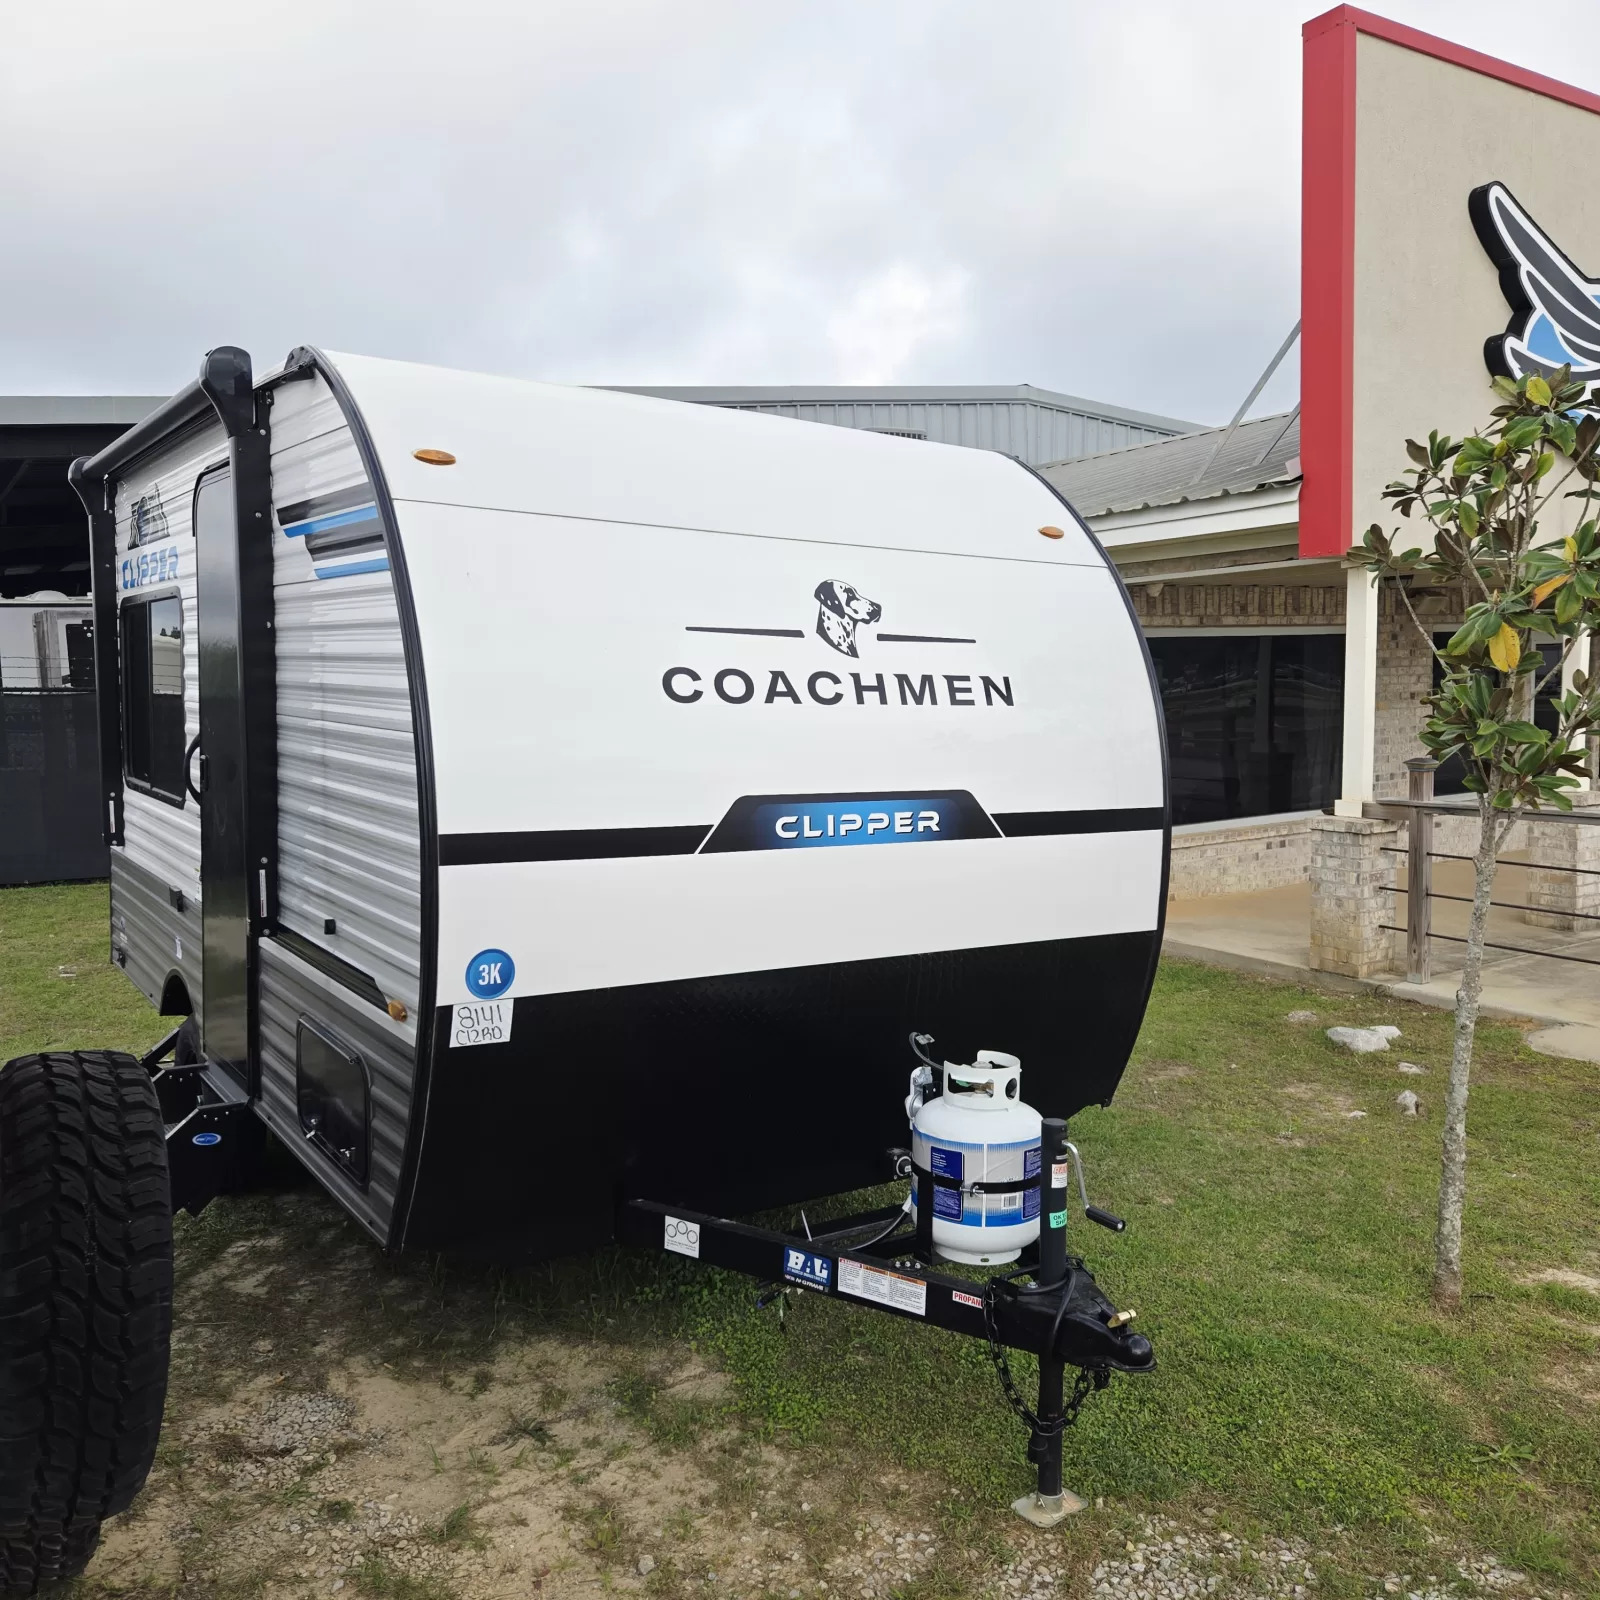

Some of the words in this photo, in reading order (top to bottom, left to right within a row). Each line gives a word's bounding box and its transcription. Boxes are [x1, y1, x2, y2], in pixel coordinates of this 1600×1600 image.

[122, 546, 179, 590] CLIPPER
[662, 667, 1015, 707] COACHMEN
[775, 810, 942, 839] CLIPPER
[478, 962, 502, 986] 3K
[457, 1004, 502, 1029] 8141
[788, 1250, 828, 1279] BAL
[954, 1292, 983, 1307] PROPAN
